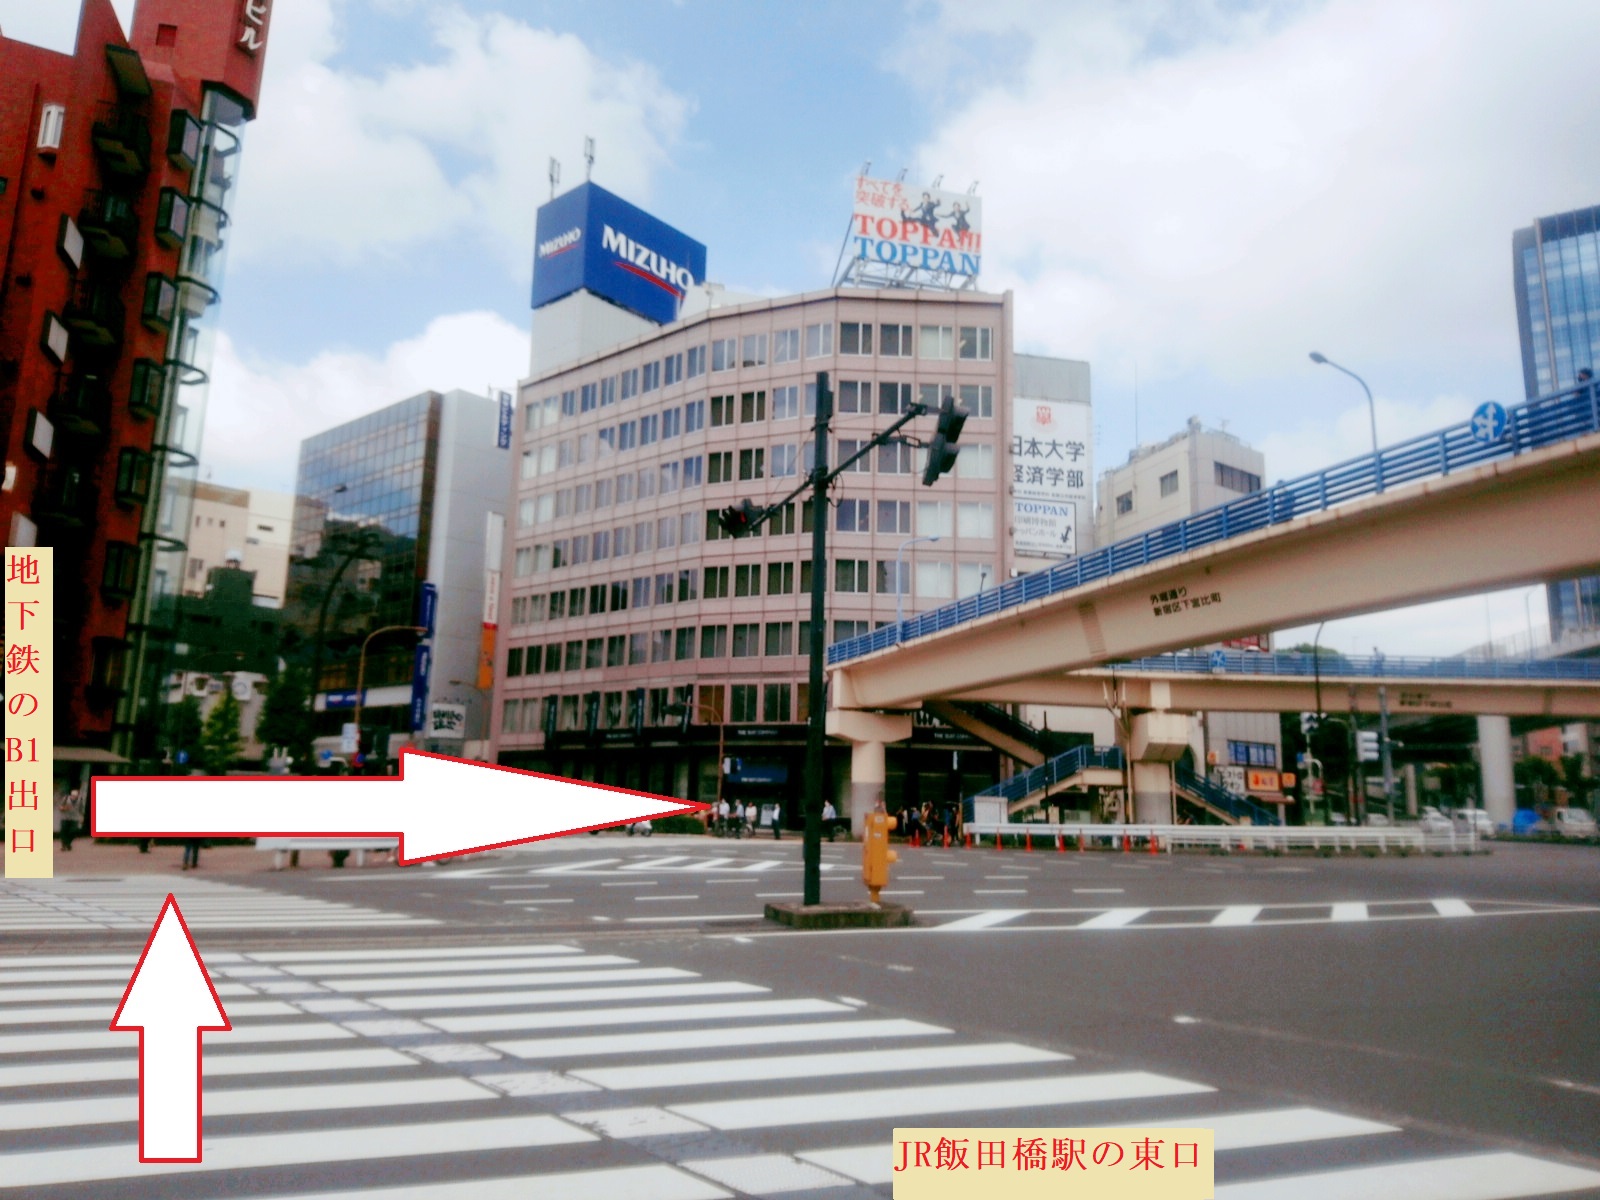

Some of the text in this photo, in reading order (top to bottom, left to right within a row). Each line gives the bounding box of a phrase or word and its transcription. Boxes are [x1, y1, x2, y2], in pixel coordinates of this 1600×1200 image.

[539, 226, 581, 258] MIZUHO
[602, 224, 694, 291] MIZUHO
[854, 236, 981, 276] TOPPAN
[1013, 435, 1085, 463] 日本大学
[1015, 502, 1068, 517] TOPPAN
